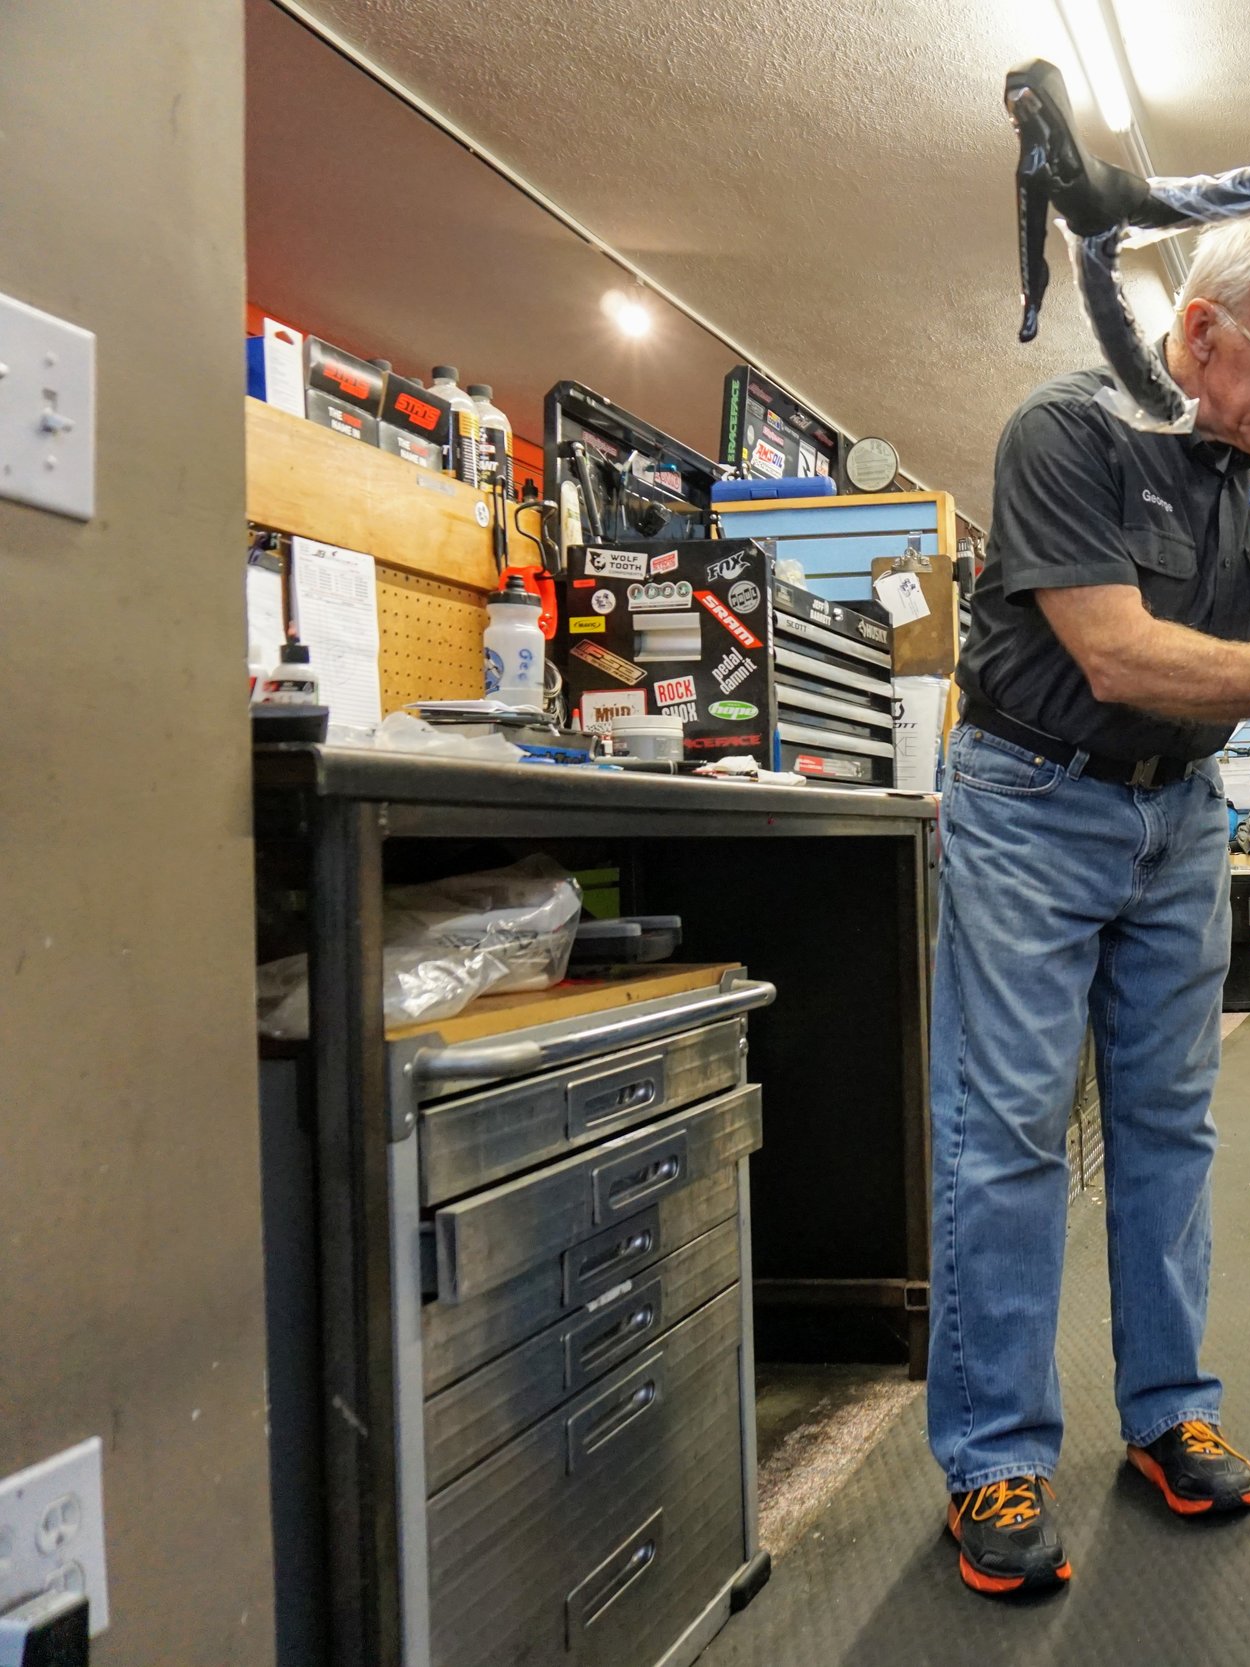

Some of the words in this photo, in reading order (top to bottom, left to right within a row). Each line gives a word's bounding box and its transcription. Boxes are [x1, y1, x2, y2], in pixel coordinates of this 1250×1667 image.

[727, 379, 741, 455] RACEFACE
[756, 443, 784, 468] AMSOIL
[1142, 489, 1174, 513] George
[609, 562, 642, 571] TOOTH
[611, 554, 638, 562] WOLF
[707, 551, 746, 582] FOX
[703, 595, 755, 646] SRAM
[786, 620, 807, 633] SCOTT
[866, 623, 888, 643] HUSKY
[711, 646, 743, 683] pedal
[658, 679, 695, 703] ROCK
[709, 703, 758, 720] hope
[683, 734, 762, 749] ACEFACE
